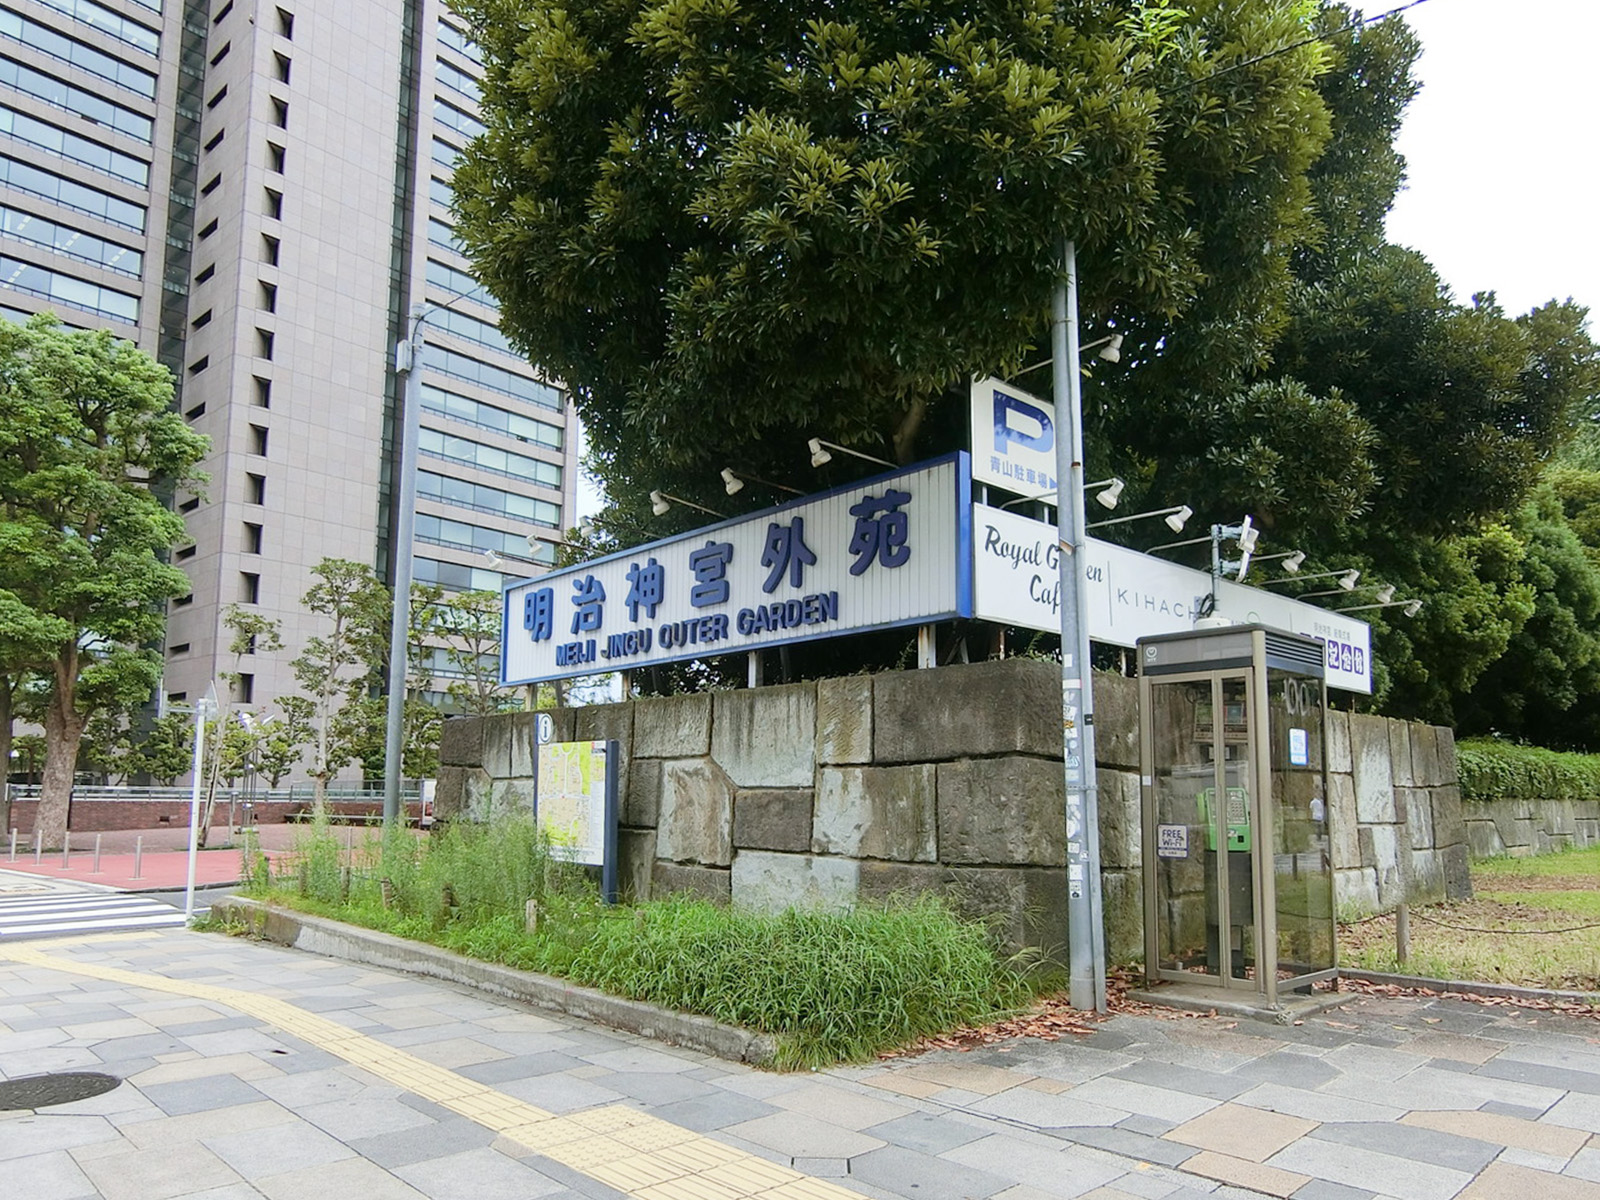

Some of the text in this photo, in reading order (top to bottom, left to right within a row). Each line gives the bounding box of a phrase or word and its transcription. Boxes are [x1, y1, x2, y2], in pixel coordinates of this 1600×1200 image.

[993, 389, 1053, 455] P
[990, 455, 1048, 489] 青山駐車場
[524, 488, 912, 643] 明治神宮外苑
[984, 525, 1102, 582] Royal Gen
[1029, 574, 1061, 614] Caf
[1117, 588, 1197, 620] KIHACH
[556, 591, 838, 666] MEIJI JINGU OUTER GARDEN
[1162, 829, 1182, 839] FREE
[1162, 838, 1182, 847] Wi-Fi
